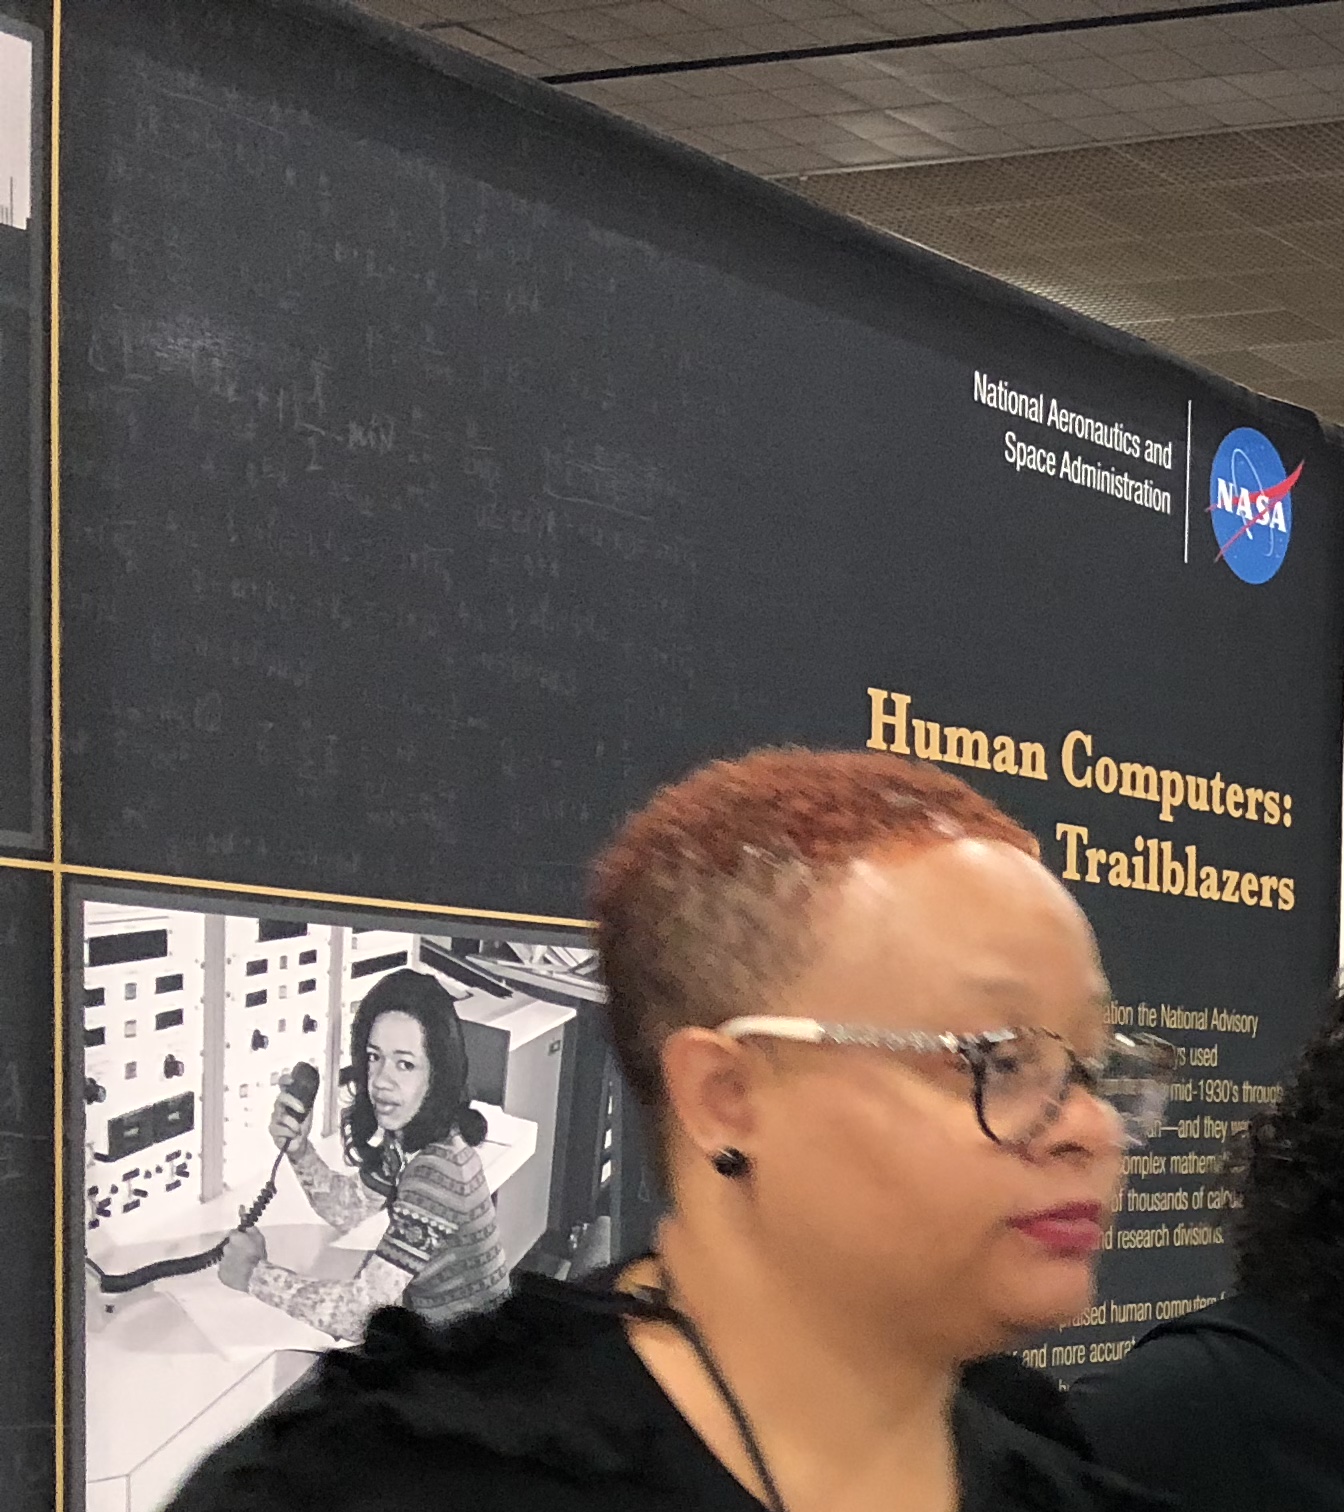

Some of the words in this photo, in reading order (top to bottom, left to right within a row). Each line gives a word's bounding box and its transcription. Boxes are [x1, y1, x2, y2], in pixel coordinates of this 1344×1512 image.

[973, 370, 1043, 423] National
[1047, 398, 1140, 458] Aeronautics
[1144, 440, 1172, 470] and
[1004, 431, 1056, 473] Space
[1060, 450, 1171, 515] Administration
[1216, 477, 1287, 533] NASA
[866, 687, 1048, 780] Human
[1061, 730, 1293, 828] Computers:
[1055, 823, 1295, 911] Trailblazers
[1138, 1001, 1156, 1027] the
[1160, 1003, 1208, 1030] National
[1211, 1007, 1258, 1038] Advisory
[1190, 1043, 1218, 1067] used
[1170, 1078, 1239, 1103] mid-1930's
[1203, 1116, 1228, 1143] they
[1121, 1153, 1166, 1179] omplex
[1127, 1187, 1188, 1211] thousands
[1192, 1186, 1205, 1209] of
[1117, 1223, 1169, 1248] research
[1173, 1222, 1224, 1246] divisions.
[1110, 1299, 1151, 1323] human
[1023, 1344, 1047, 1368] and
[1052, 1342, 1085, 1366] more
